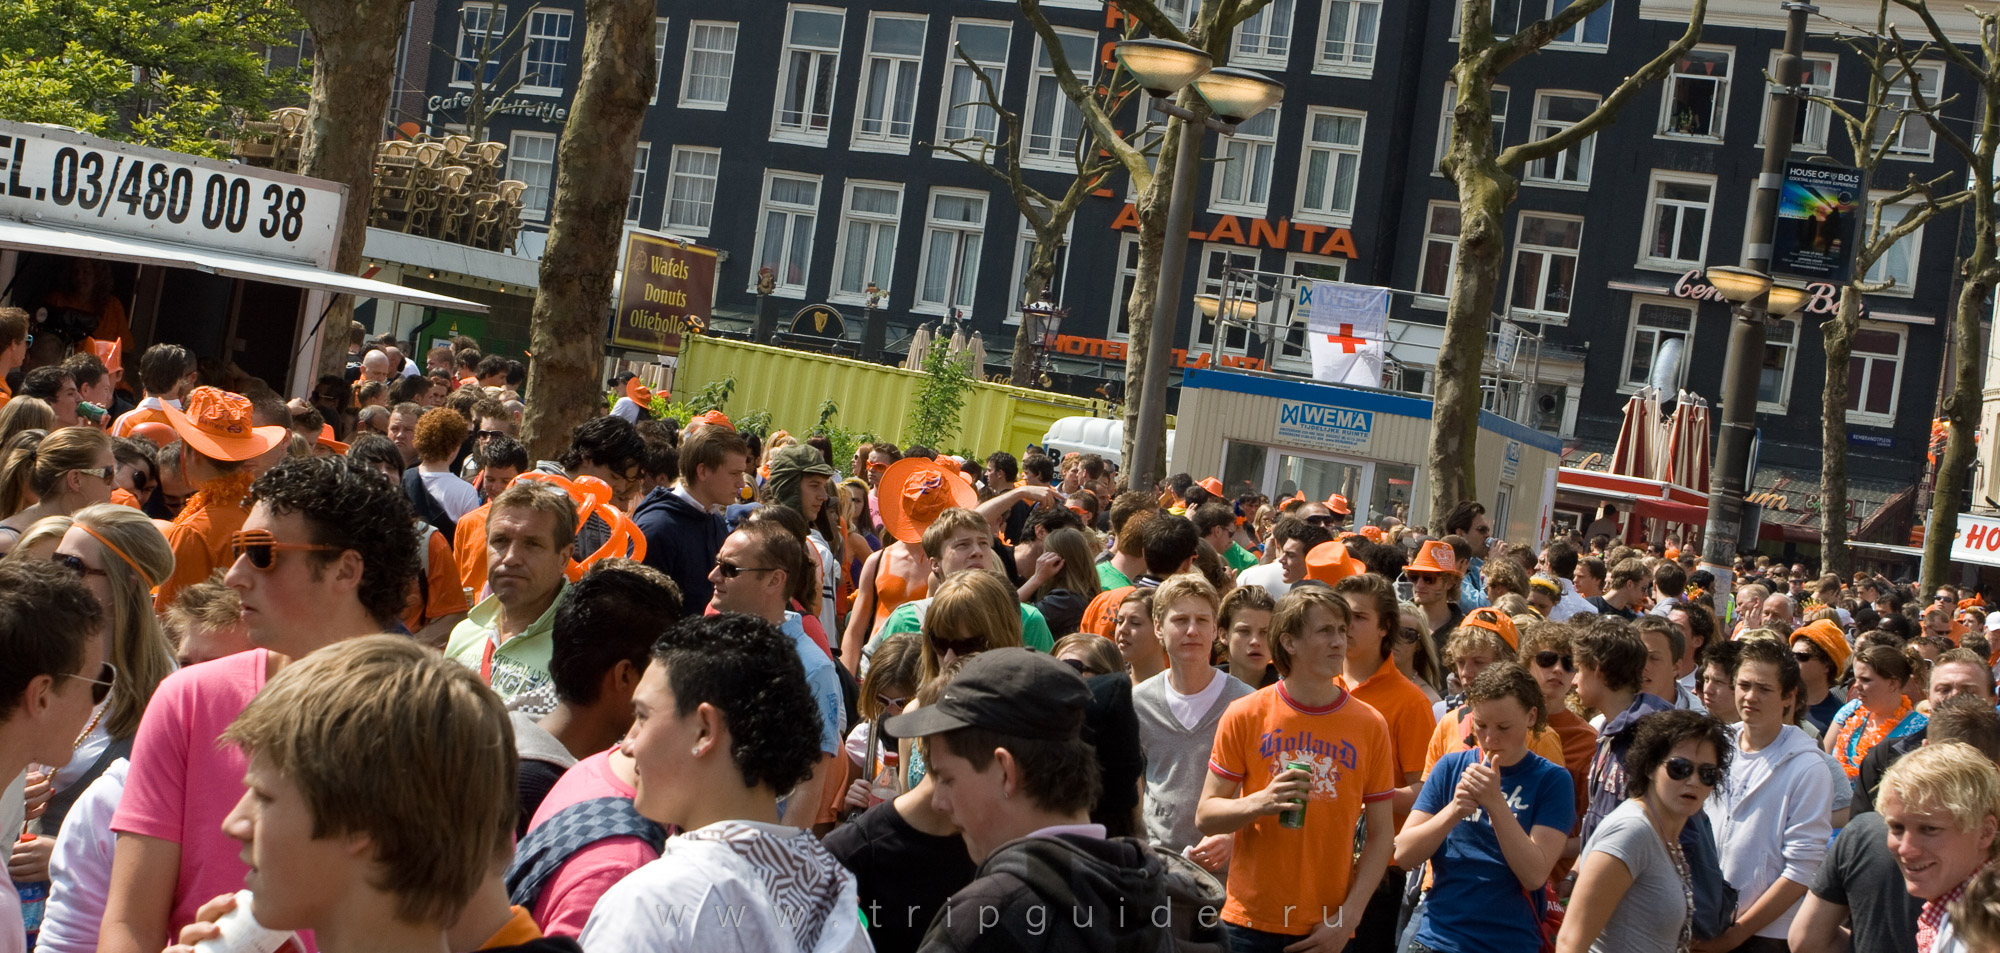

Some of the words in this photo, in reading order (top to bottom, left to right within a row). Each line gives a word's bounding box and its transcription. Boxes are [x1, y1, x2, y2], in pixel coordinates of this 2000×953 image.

[1789, 176, 1809, 184] COCKTAIL
[1833, 181, 1858, 189] EXPERIENCE
[1790, 168, 1817, 178] HOUSE
[1818, 171, 1830, 179] OF
[1838, 173, 1859, 183] BOLS
[202, 174, 250, 233] 00
[259, 183, 306, 242] 38
[1111, 203, 1359, 259] AANTA
[651, 256, 689, 280] Wafels
[644, 283, 687, 308] Donuts
[630, 309, 686, 335] Oliebolle
[1170, 347, 1272, 372] TLANTA
[1300, 423, 1340, 434] TIJDELIJKE
[1342, 429, 1369, 438] RUIMTE
[1304, 405, 1367, 431] WEMA
[1853, 434, 1891, 444] REMBRANDTPLEIN
